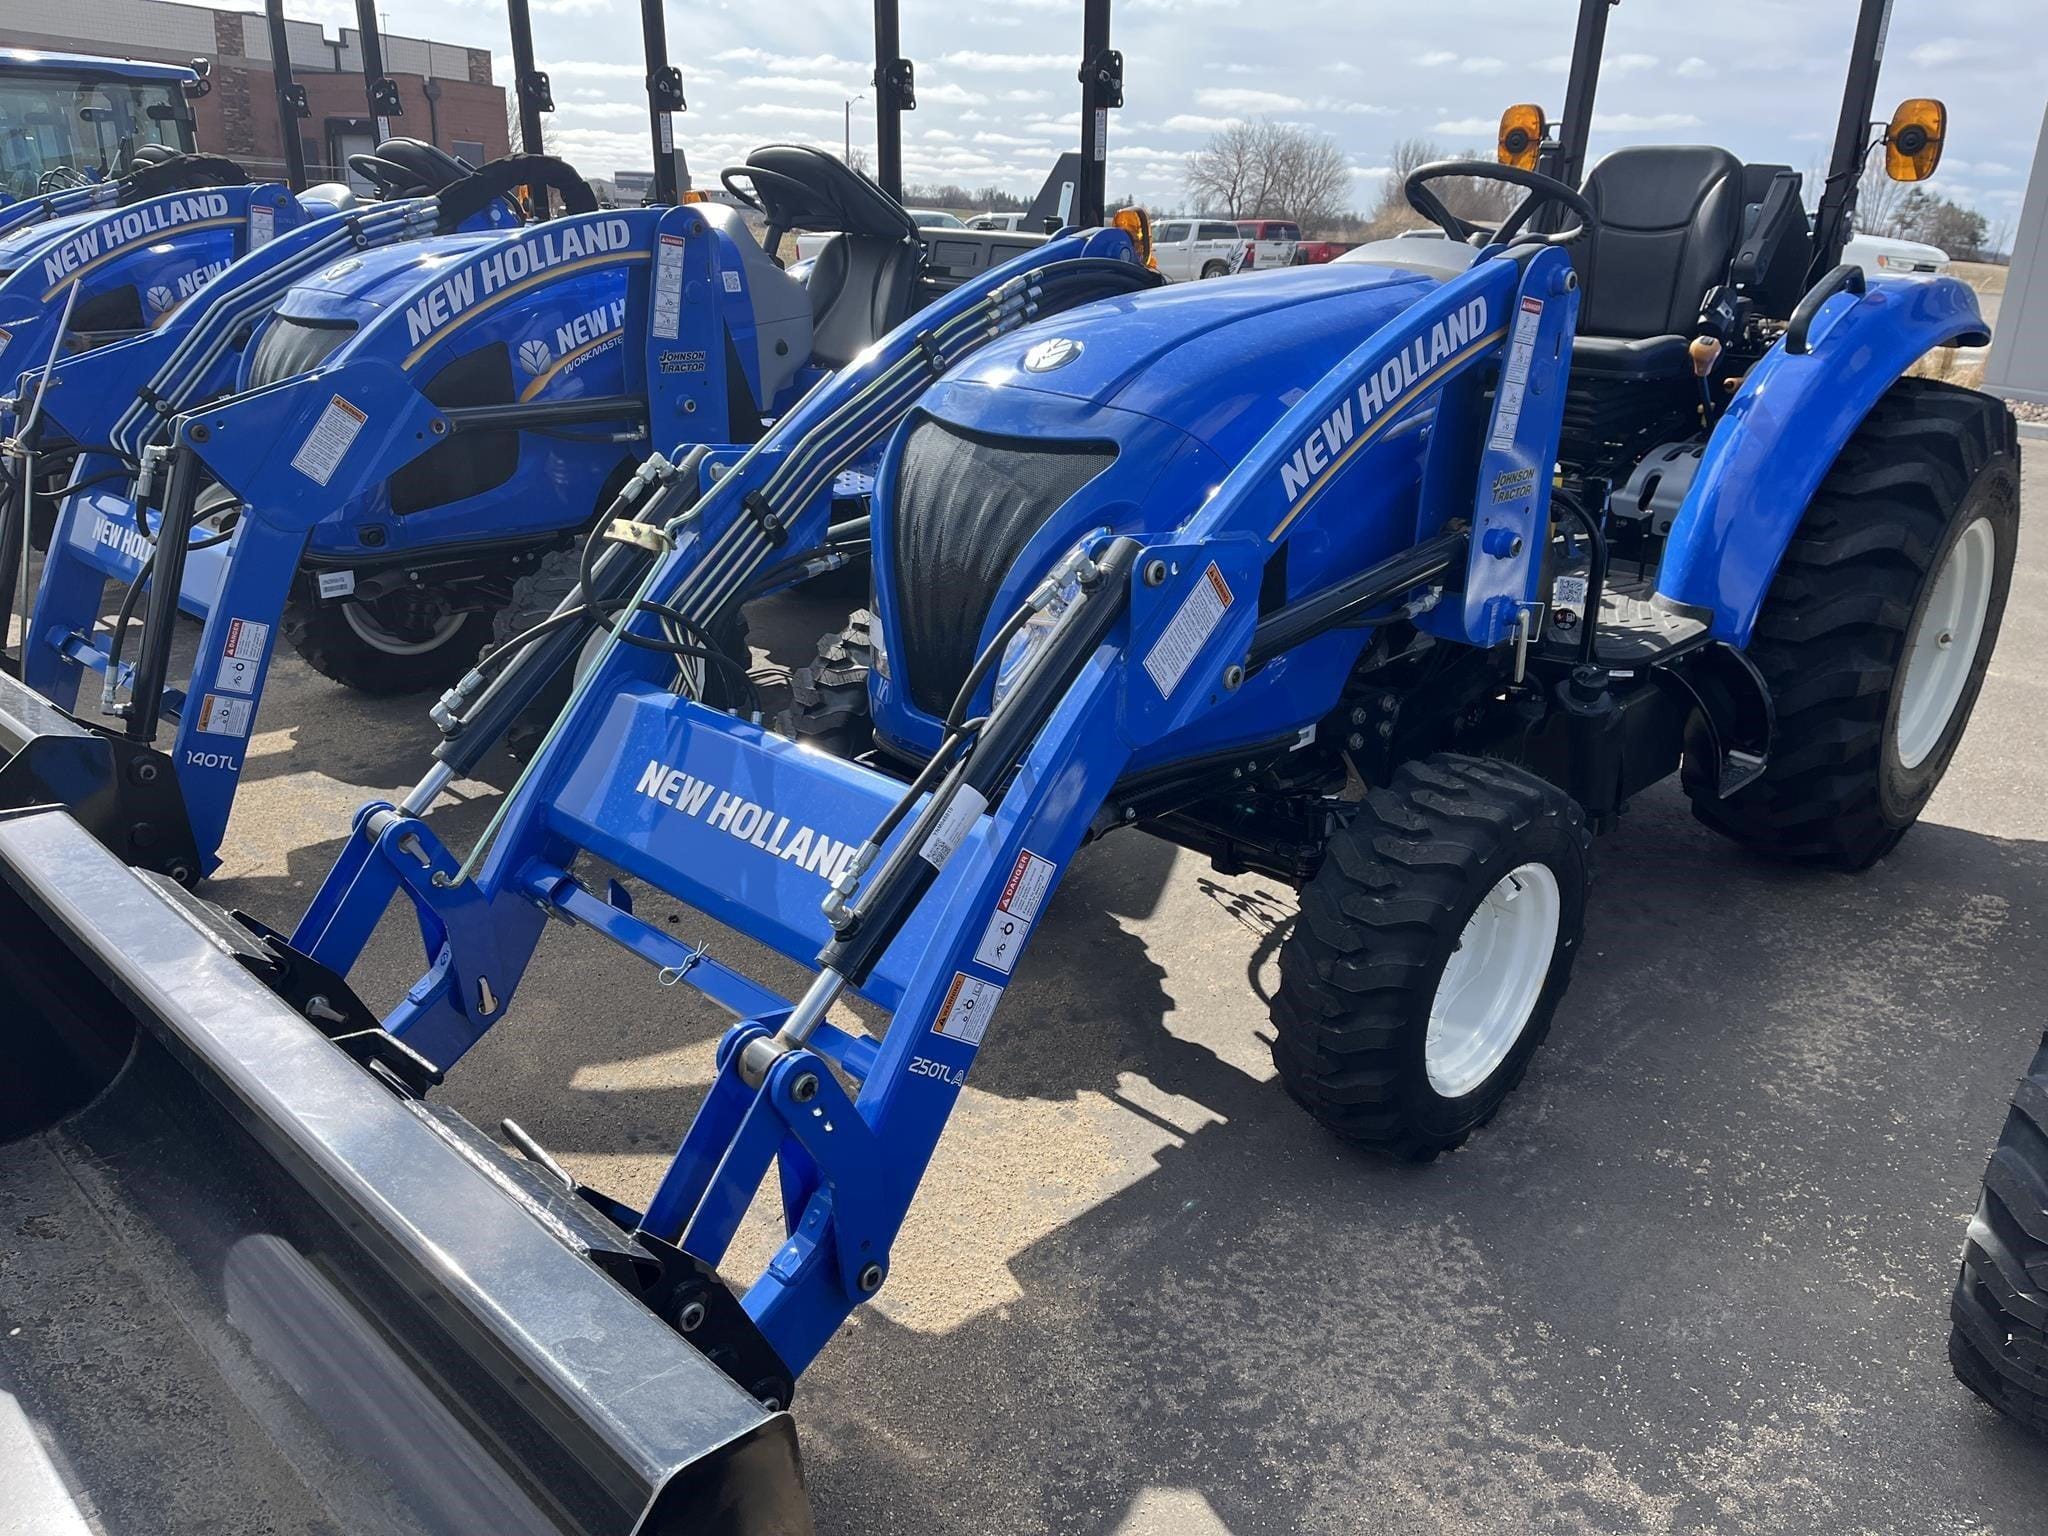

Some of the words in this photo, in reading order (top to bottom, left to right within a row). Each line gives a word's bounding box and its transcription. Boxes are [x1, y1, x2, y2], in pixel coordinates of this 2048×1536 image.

[43, 228, 99, 286] NEW
[102, 194, 229, 249] HOLLAND
[177, 261, 222, 297] NEW
[405, 266, 475, 347] NEW
[479, 219, 630, 295] HOLLAND
[556, 305, 608, 355] NEW
[564, 335, 624, 375] WORKMASTE
[659, 350, 705, 361] JOHNSON
[660, 361, 705, 374] TRACTOR
[1279, 398, 1354, 503] NEW
[1358, 295, 1487, 424] HOLLAND
[1492, 466, 1535, 488] JOHNSON
[1492, 484, 1532, 505] TRACTOR
[92, 516, 123, 549] NEW
[230, 621, 241, 649] DANGER
[186, 750, 238, 771] 140TL
[636, 760, 716, 817] NEW
[1005, 854, 1029, 897] DANGER
[943, 980, 962, 1016] WARNING
[908, 1055, 964, 1087] 250TLA
